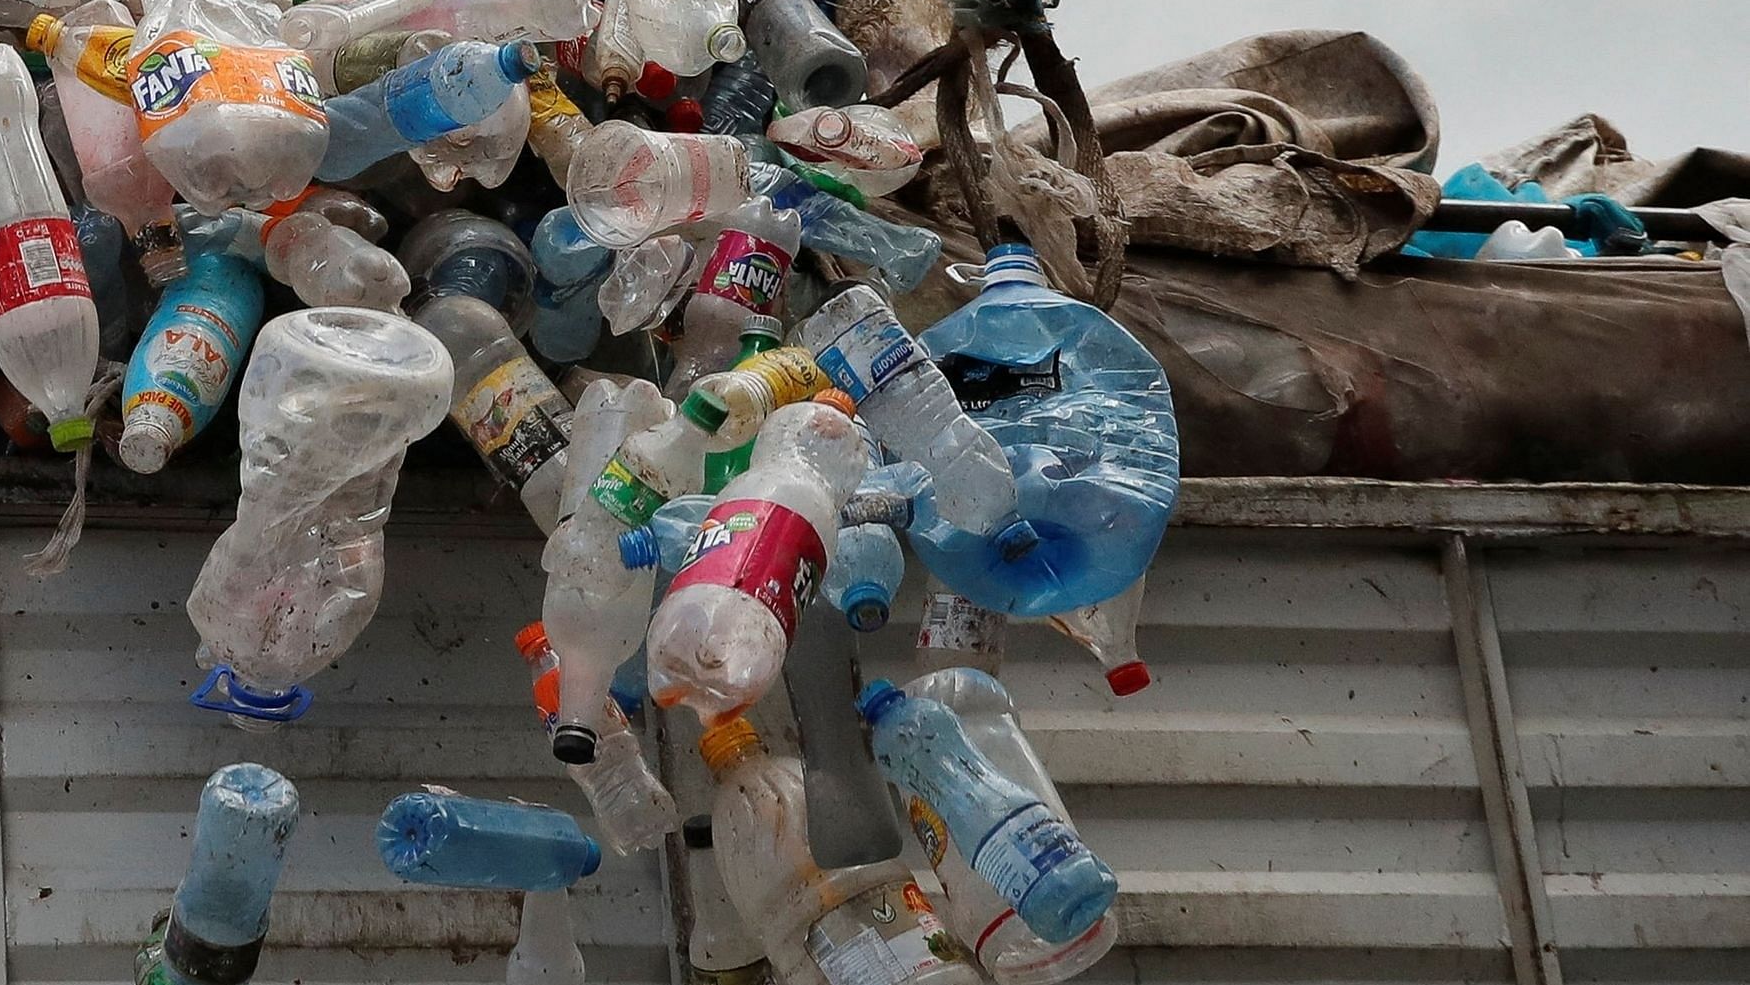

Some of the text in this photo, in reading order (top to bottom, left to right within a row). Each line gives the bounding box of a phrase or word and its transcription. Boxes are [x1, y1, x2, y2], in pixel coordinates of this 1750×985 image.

[131, 47, 212, 112] FANTA
[728, 260, 781, 300] FANTA
[138, 391, 168, 406] PACK
